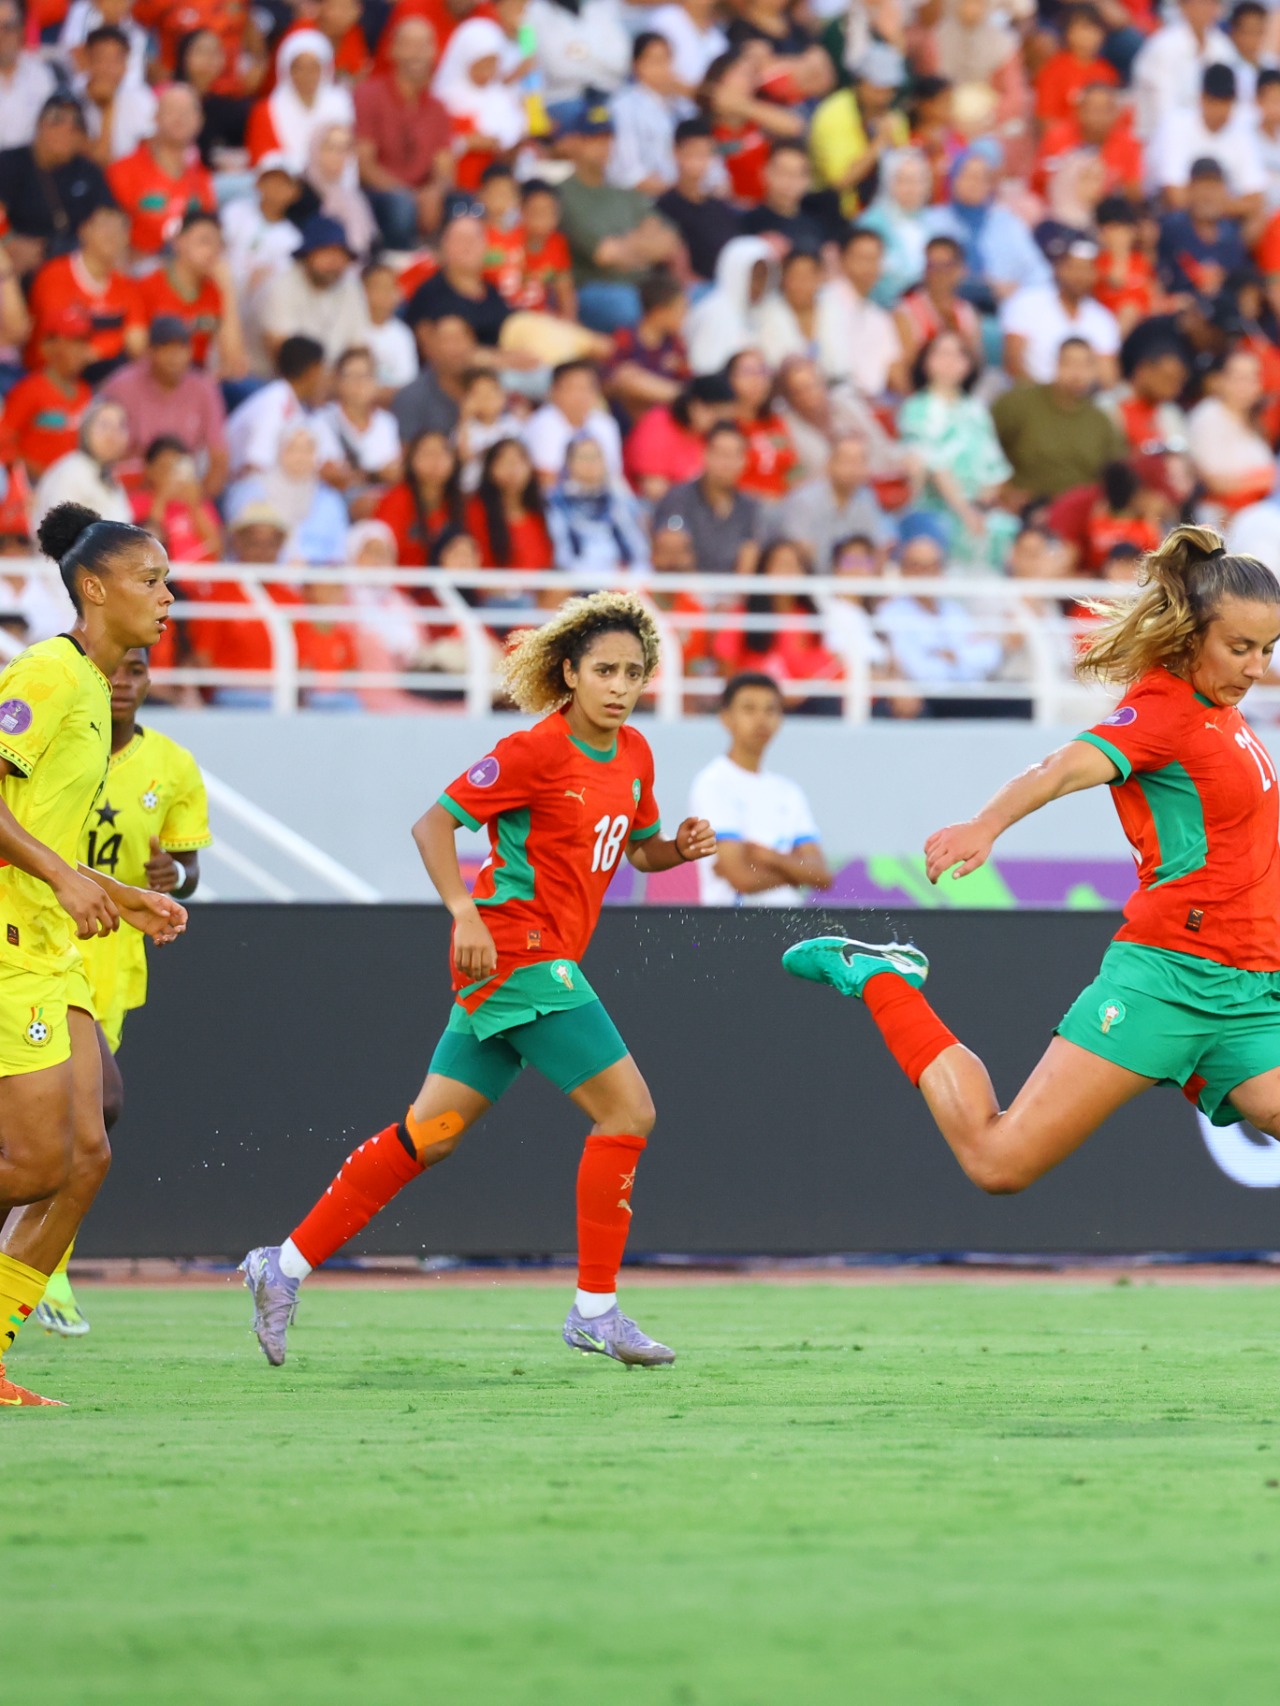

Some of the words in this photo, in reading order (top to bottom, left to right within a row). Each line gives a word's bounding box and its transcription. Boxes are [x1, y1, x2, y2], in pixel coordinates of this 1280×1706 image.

[1234, 726, 1277, 792] 21
[88, 830, 122, 874] 14
[591, 814, 629, 873] 18
